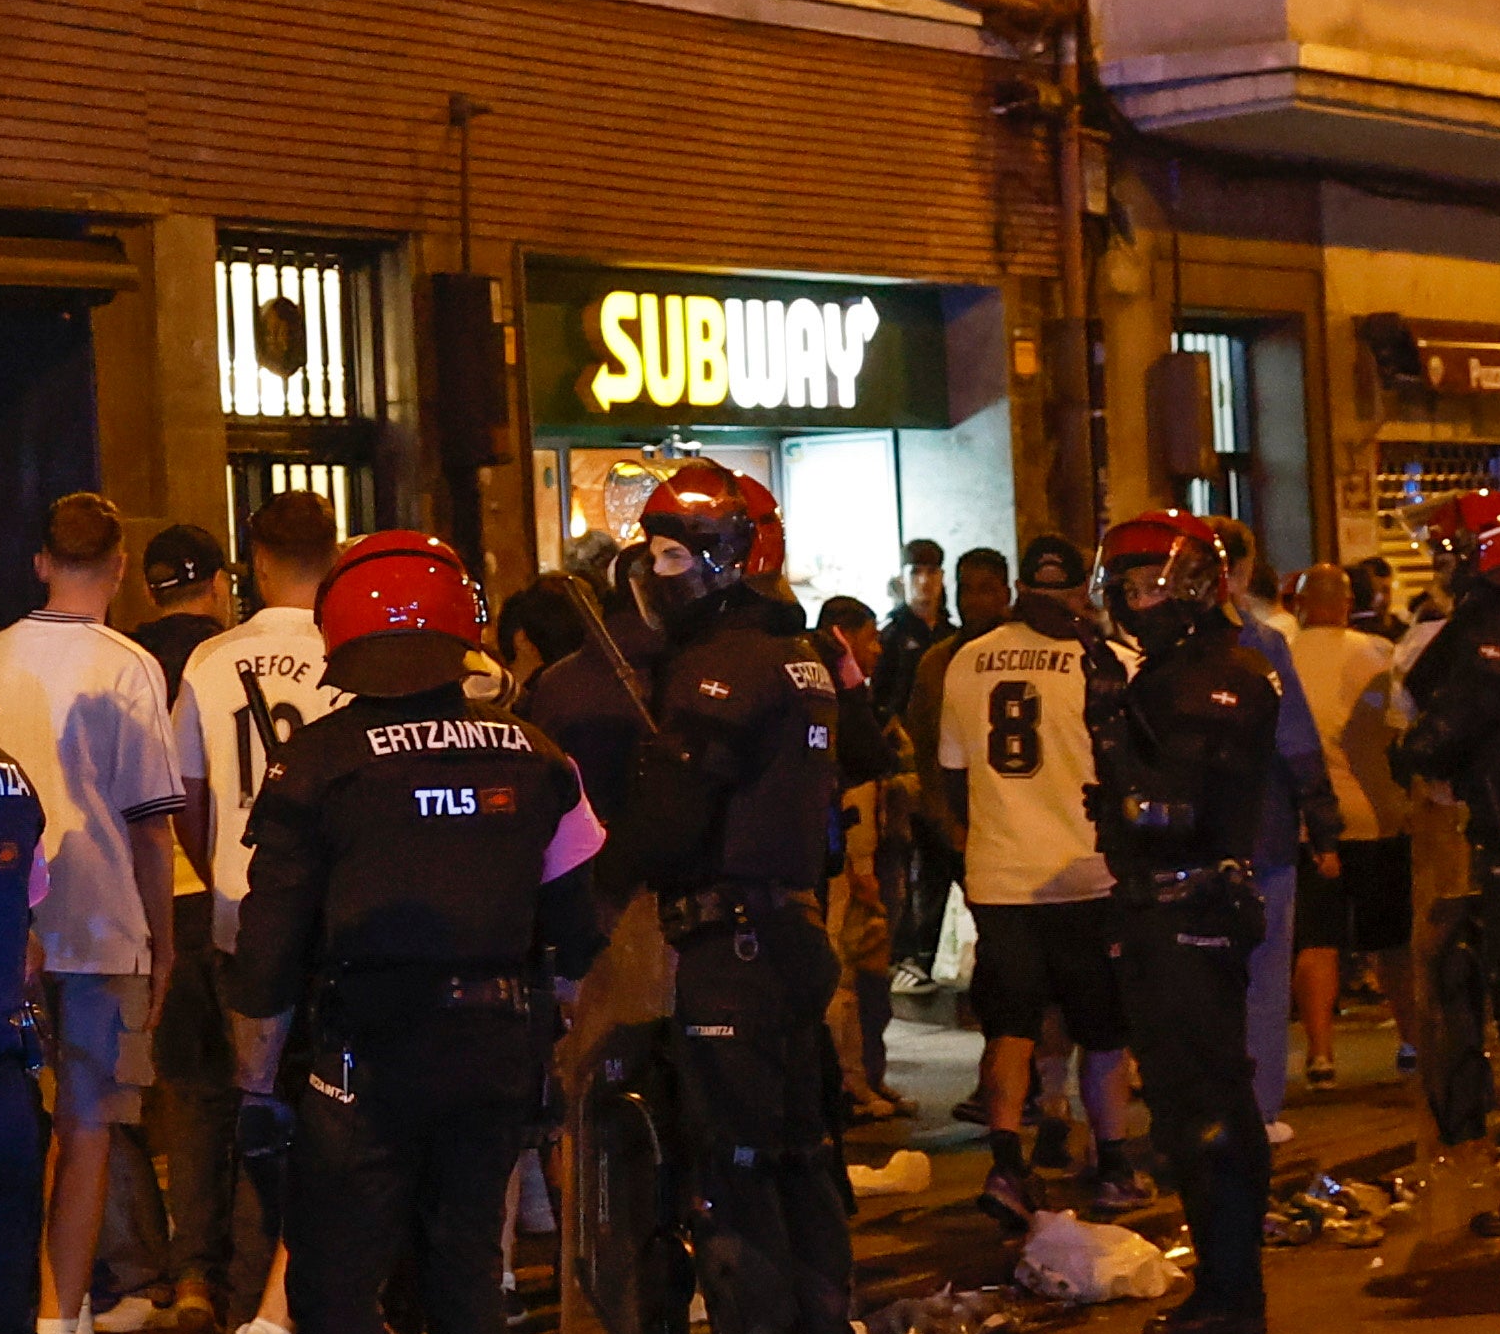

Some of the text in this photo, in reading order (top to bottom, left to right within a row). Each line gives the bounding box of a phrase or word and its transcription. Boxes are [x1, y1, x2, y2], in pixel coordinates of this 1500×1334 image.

[591, 291, 879, 412] SUBWAY
[235, 655, 312, 684] DEFOE
[975, 649, 1075, 674] GASCOIGNE
[366, 720, 533, 756] ERTZAINTZA
[987, 680, 1043, 778] 8
[415, 788, 476, 816] T7L5
